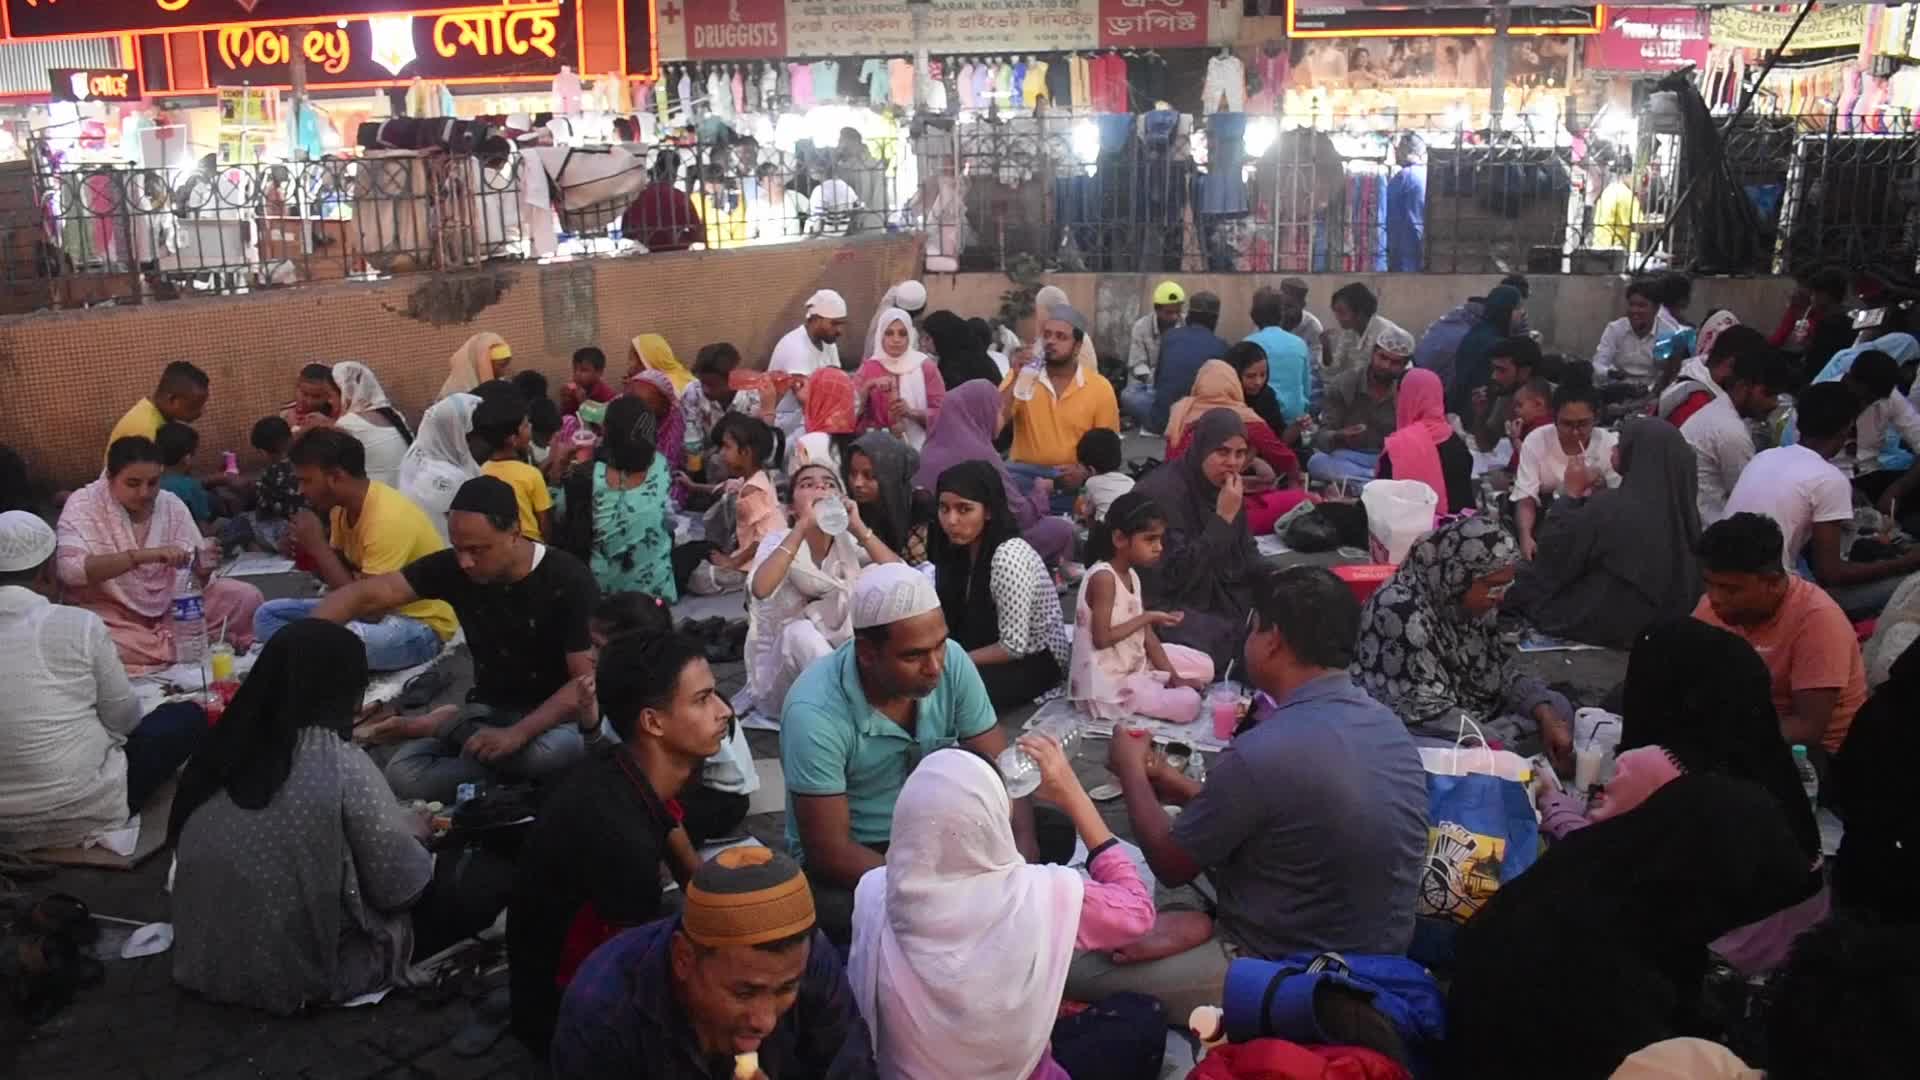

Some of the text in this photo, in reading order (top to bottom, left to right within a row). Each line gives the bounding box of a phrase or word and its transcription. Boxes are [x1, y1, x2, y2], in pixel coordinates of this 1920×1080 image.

[432, 10, 560, 58] মোহে
[694, 22, 777, 48] DRUGGISTS
[1737, 18, 1835, 35] CHARIABLE
